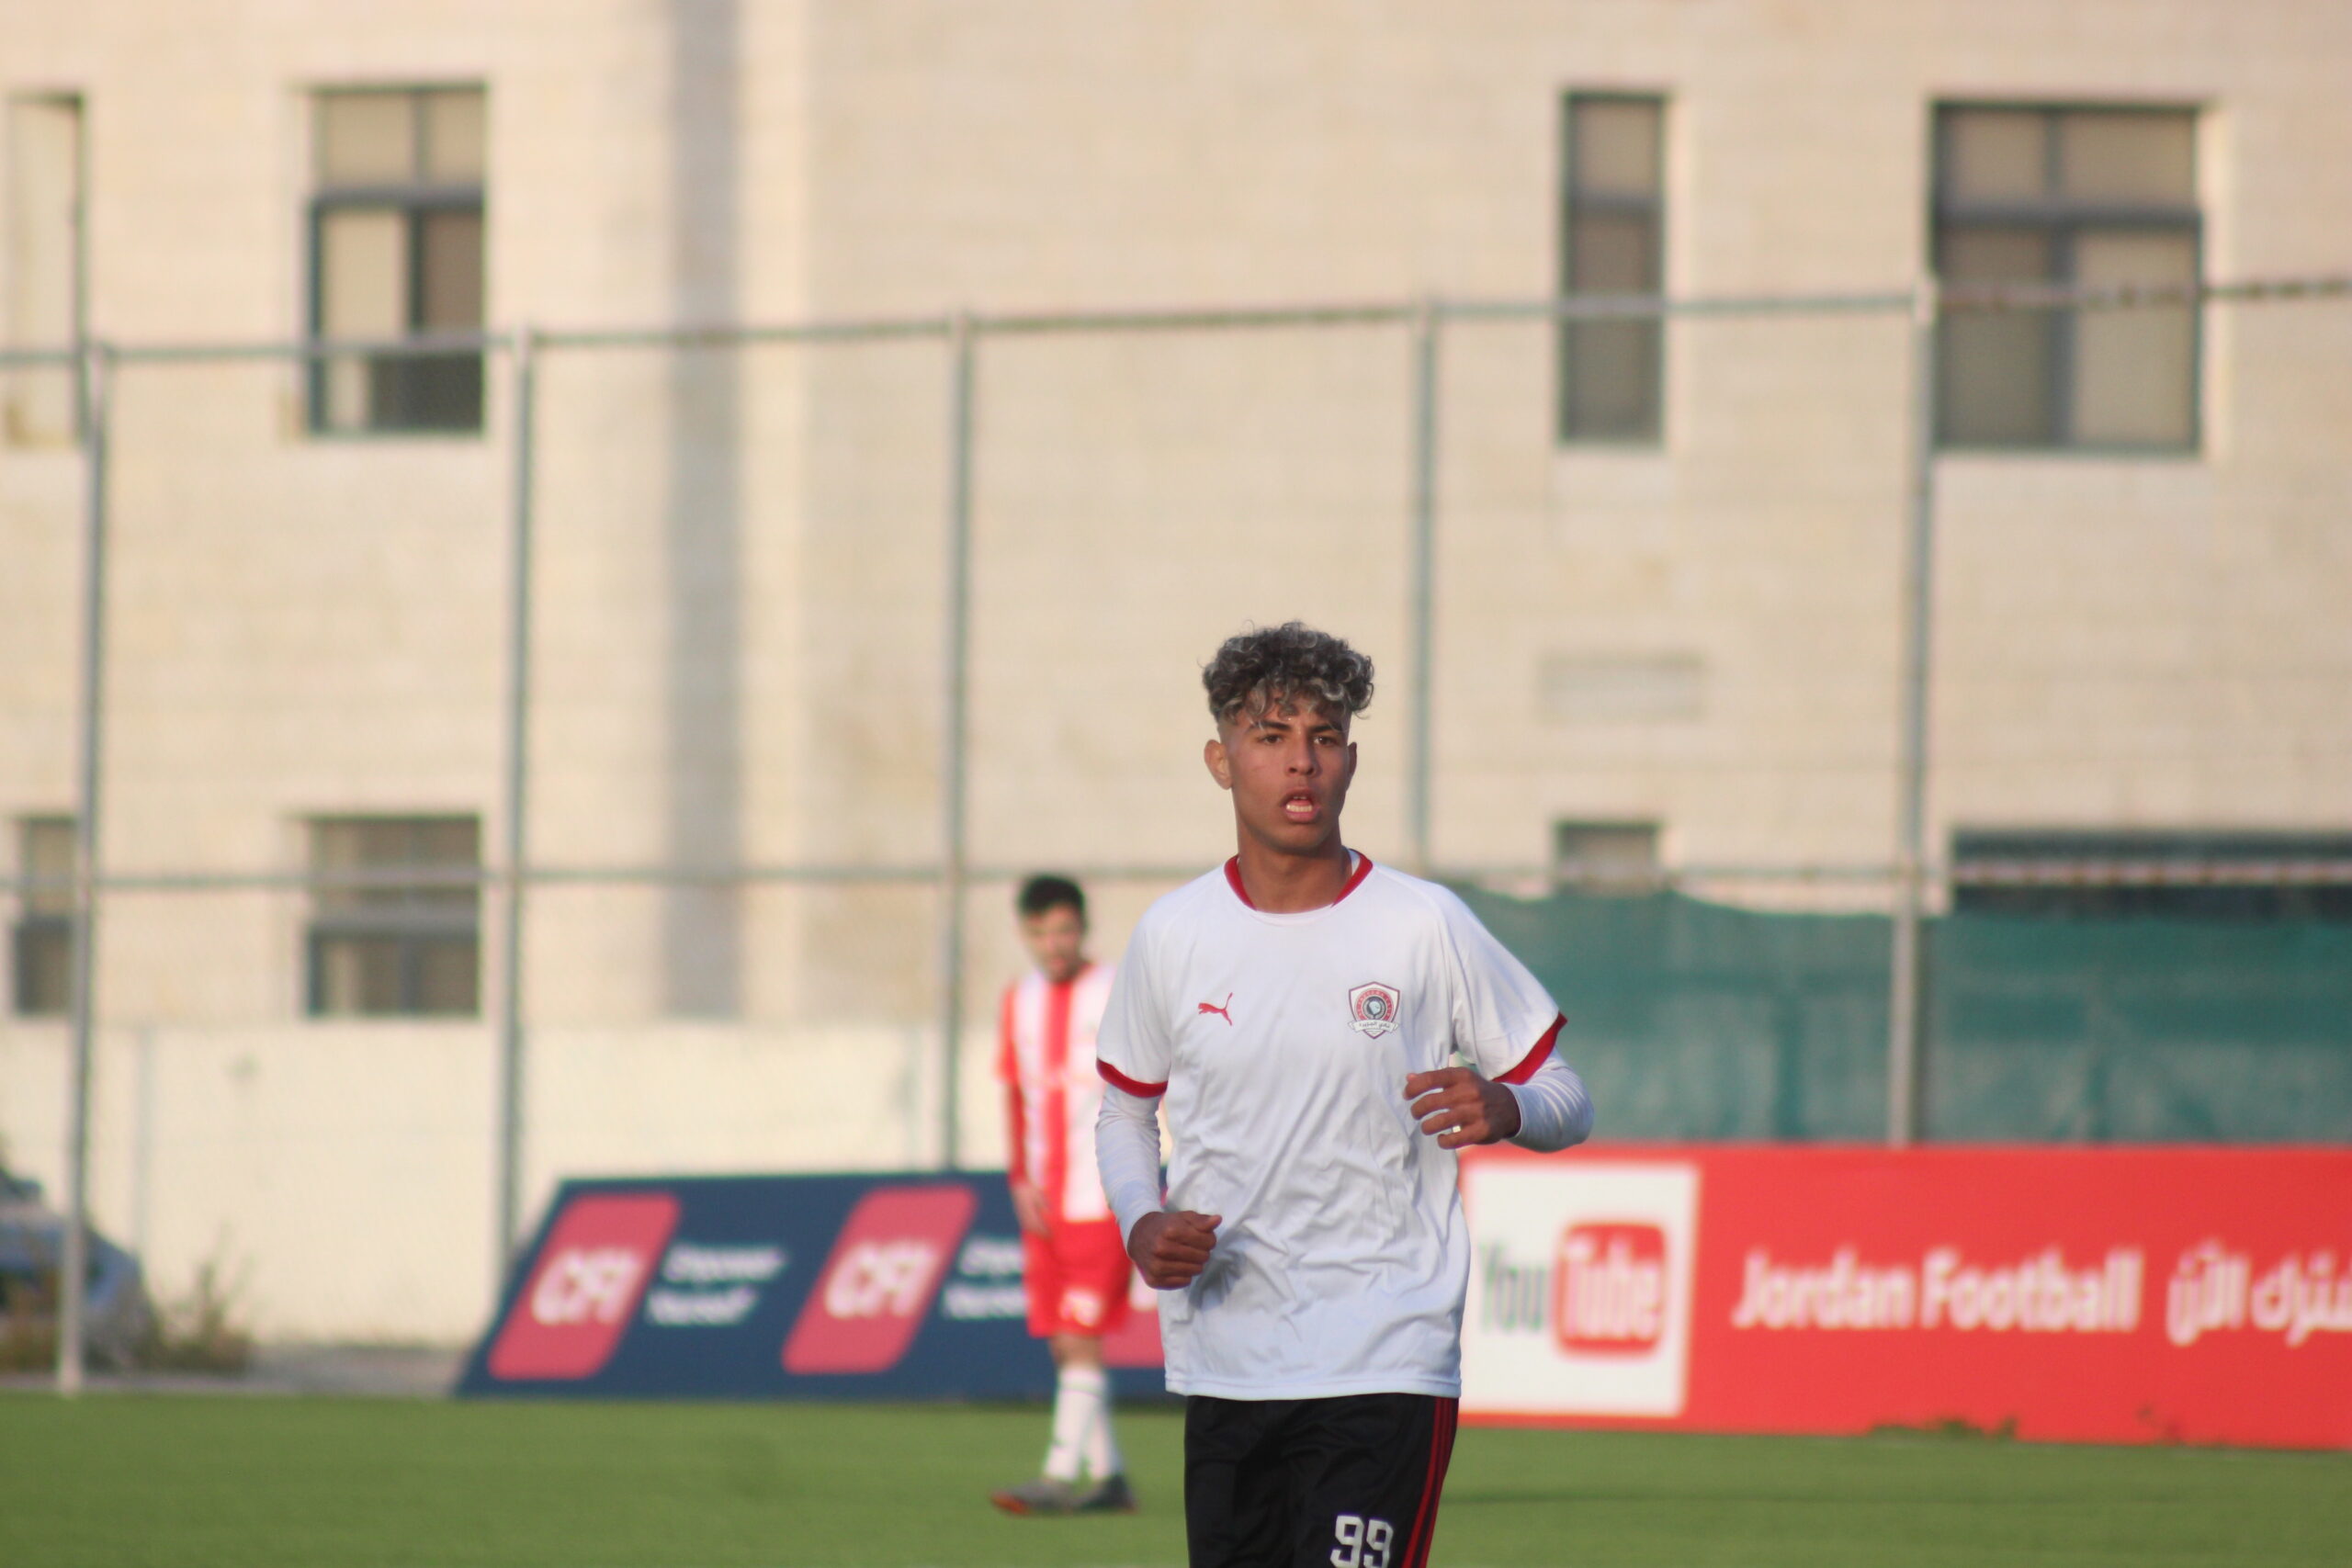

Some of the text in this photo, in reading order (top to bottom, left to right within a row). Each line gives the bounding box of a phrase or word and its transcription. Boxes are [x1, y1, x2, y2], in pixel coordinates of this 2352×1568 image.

[1478, 1235, 1661, 1338] YouTube
[1732, 1247, 2143, 1330] Jordan Football
[2165, 1239, 2248, 1346] الآن
[1330, 1515, 1394, 1568] 99
